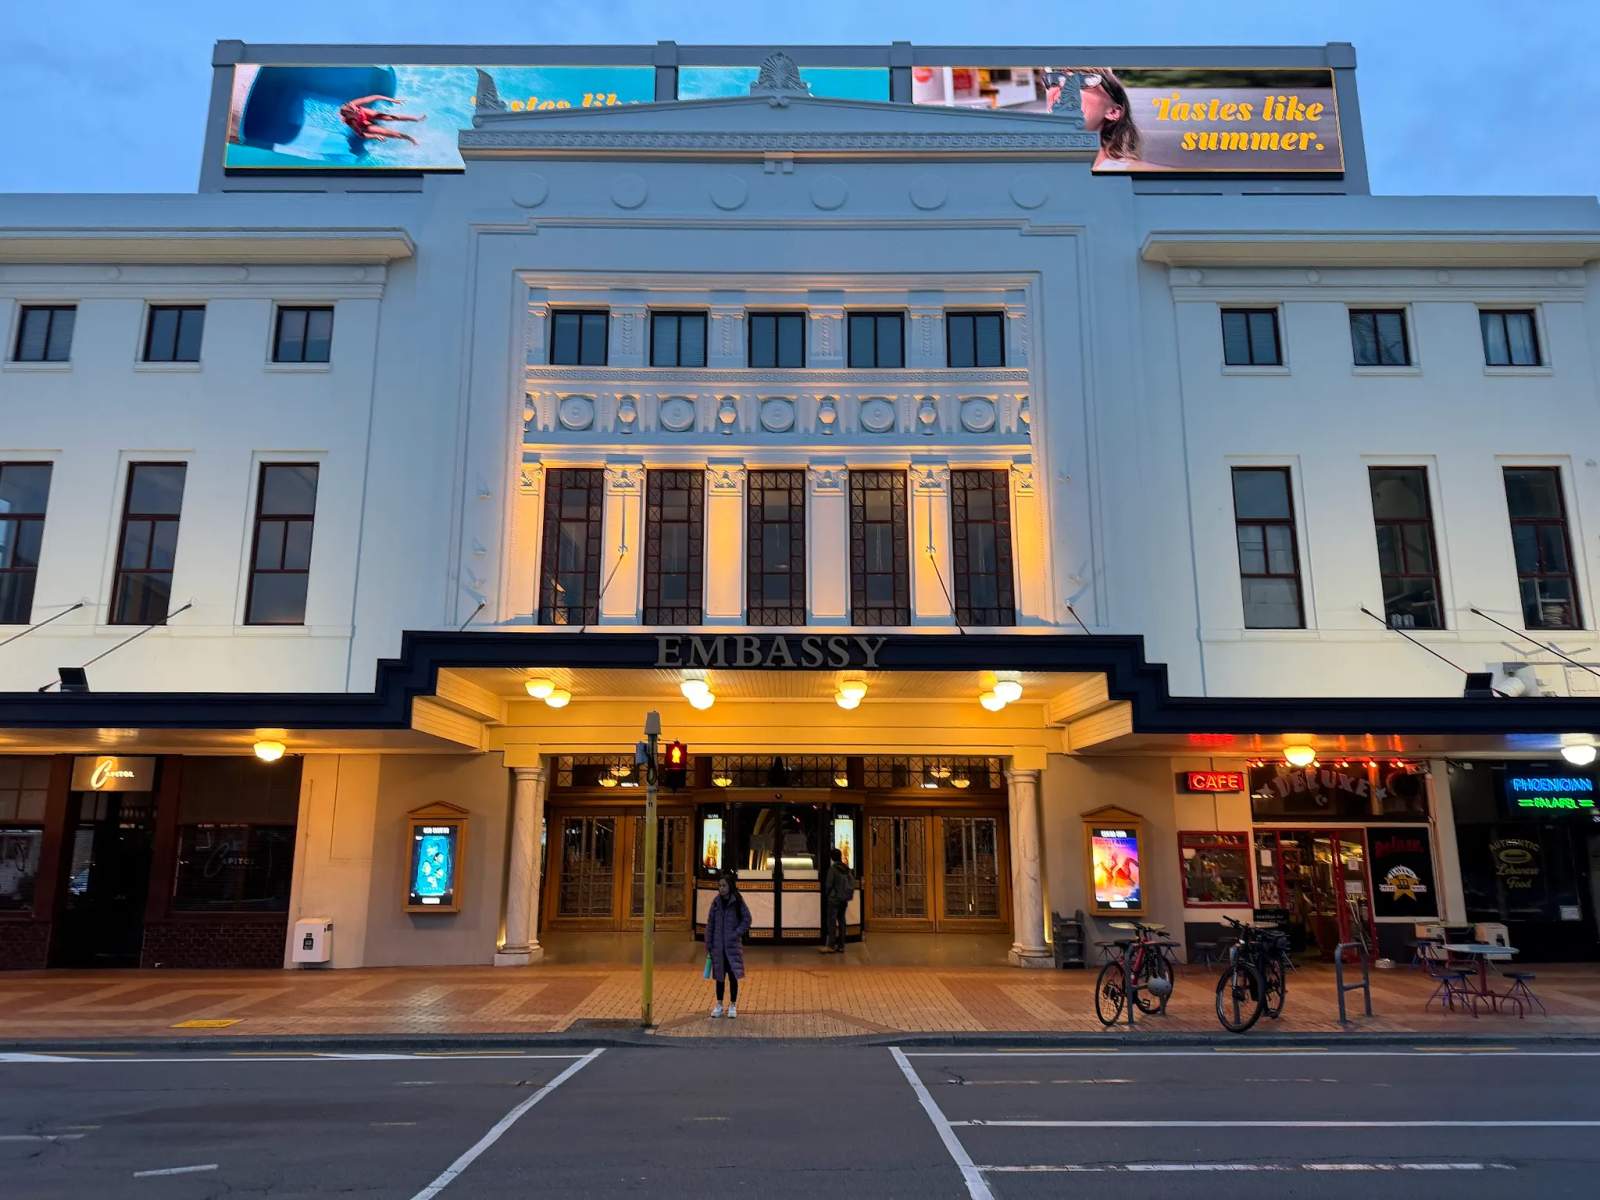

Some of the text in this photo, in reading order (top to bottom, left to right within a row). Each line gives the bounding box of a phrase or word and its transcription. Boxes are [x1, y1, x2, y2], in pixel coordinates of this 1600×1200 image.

[1152, 92, 1324, 121] Tastes like
[1181, 131, 1325, 151] summer.
[654, 634, 888, 668] EMBASSY
[1192, 774, 1239, 789] CAFE
[1512, 777, 1593, 792] PHOENICIAN
